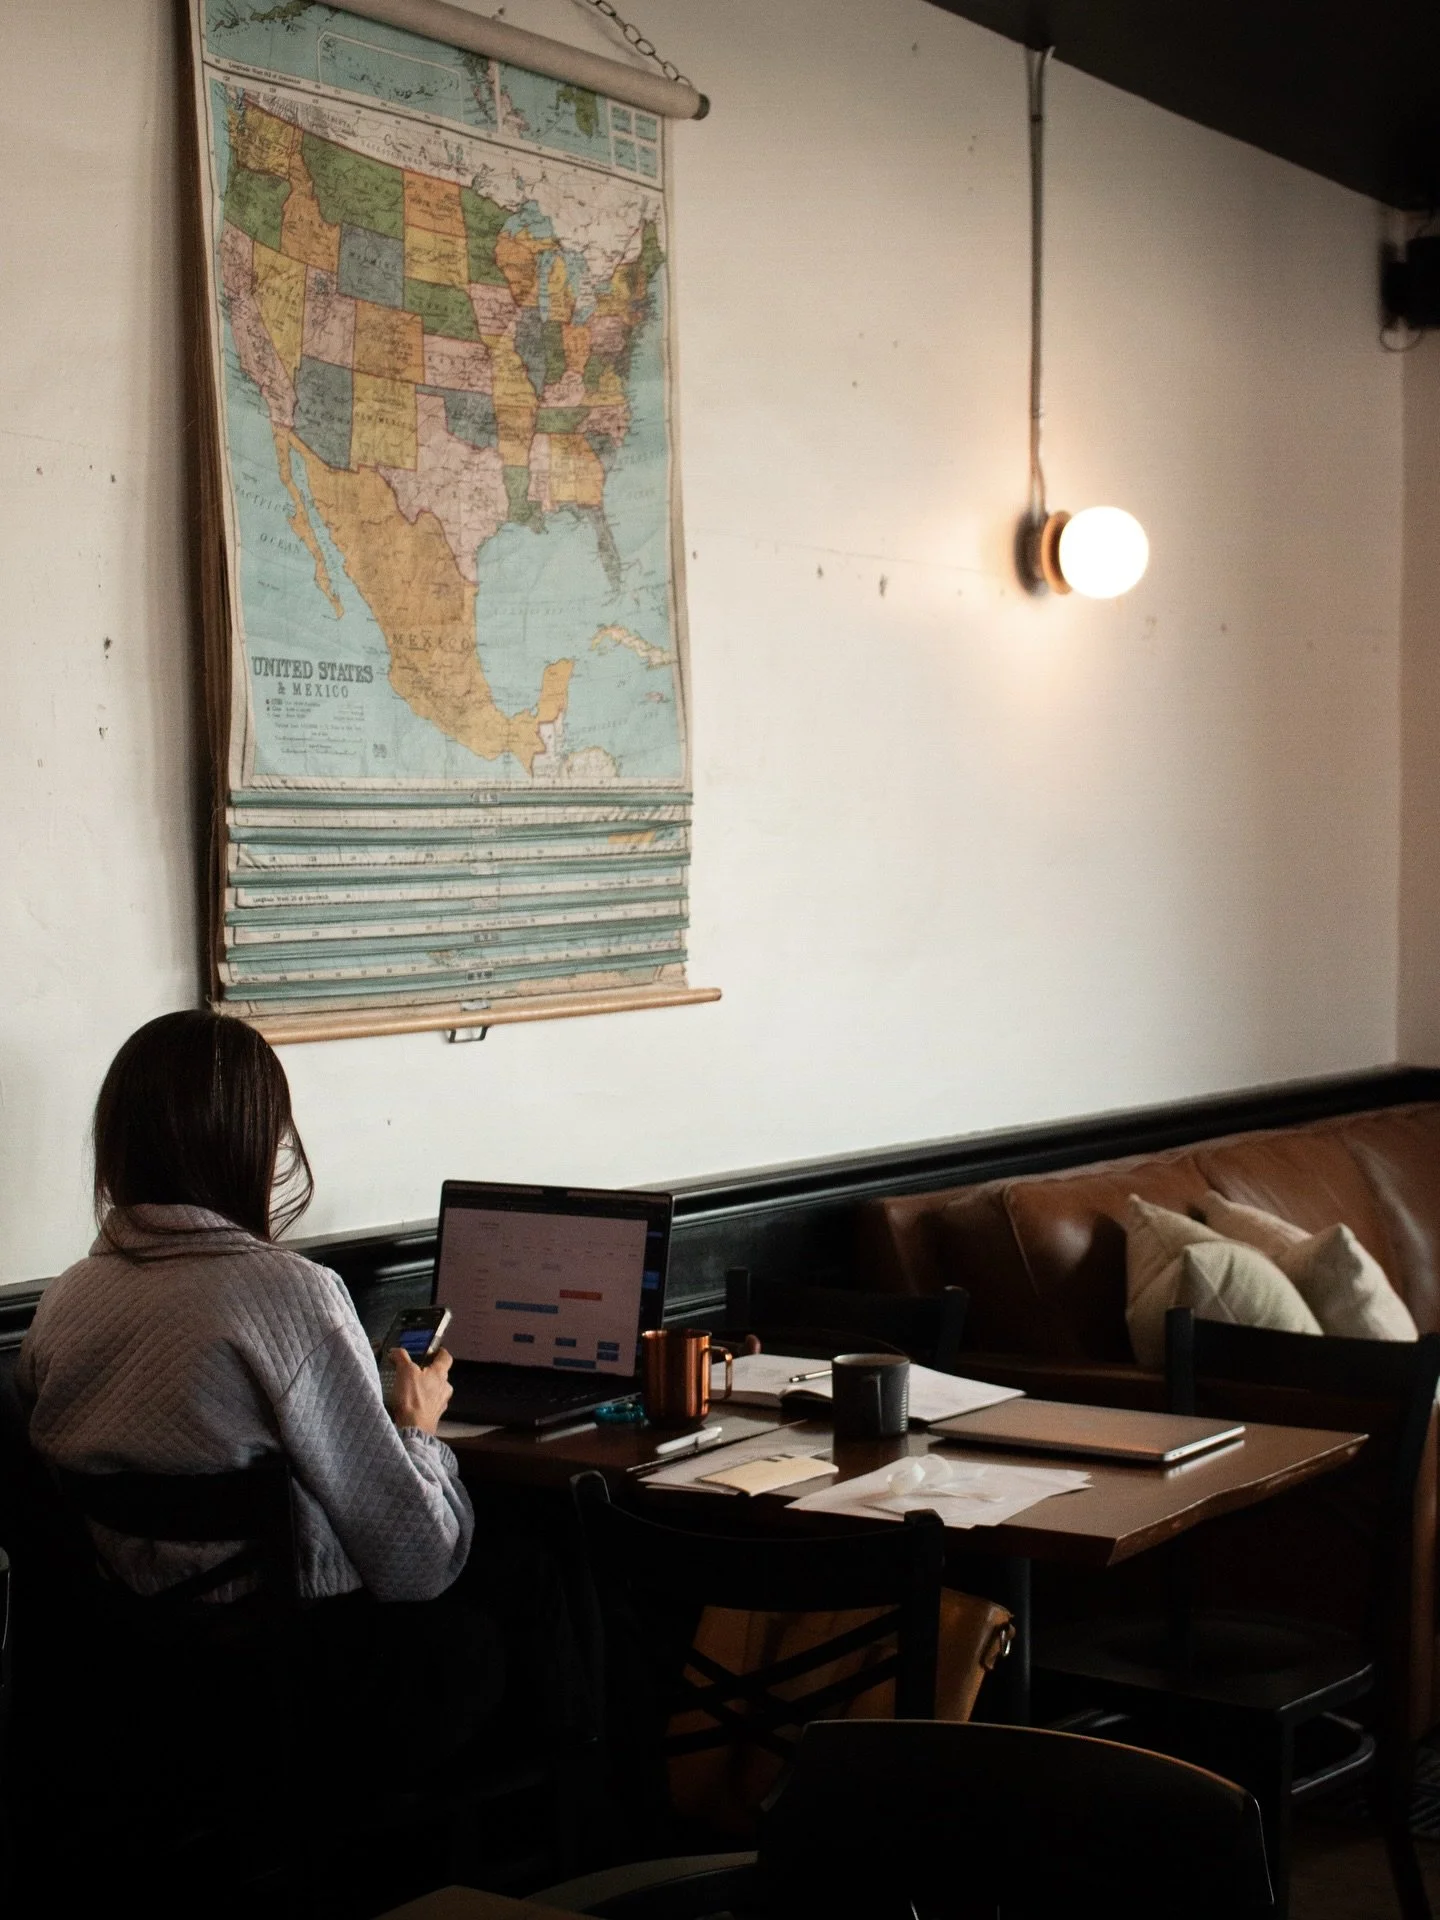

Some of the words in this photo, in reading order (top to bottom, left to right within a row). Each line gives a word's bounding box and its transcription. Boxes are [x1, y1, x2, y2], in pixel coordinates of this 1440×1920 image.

[251, 656, 313, 679] UNITED
[318, 661, 374, 684] STATES
[292, 682, 349, 698] MEXICO
